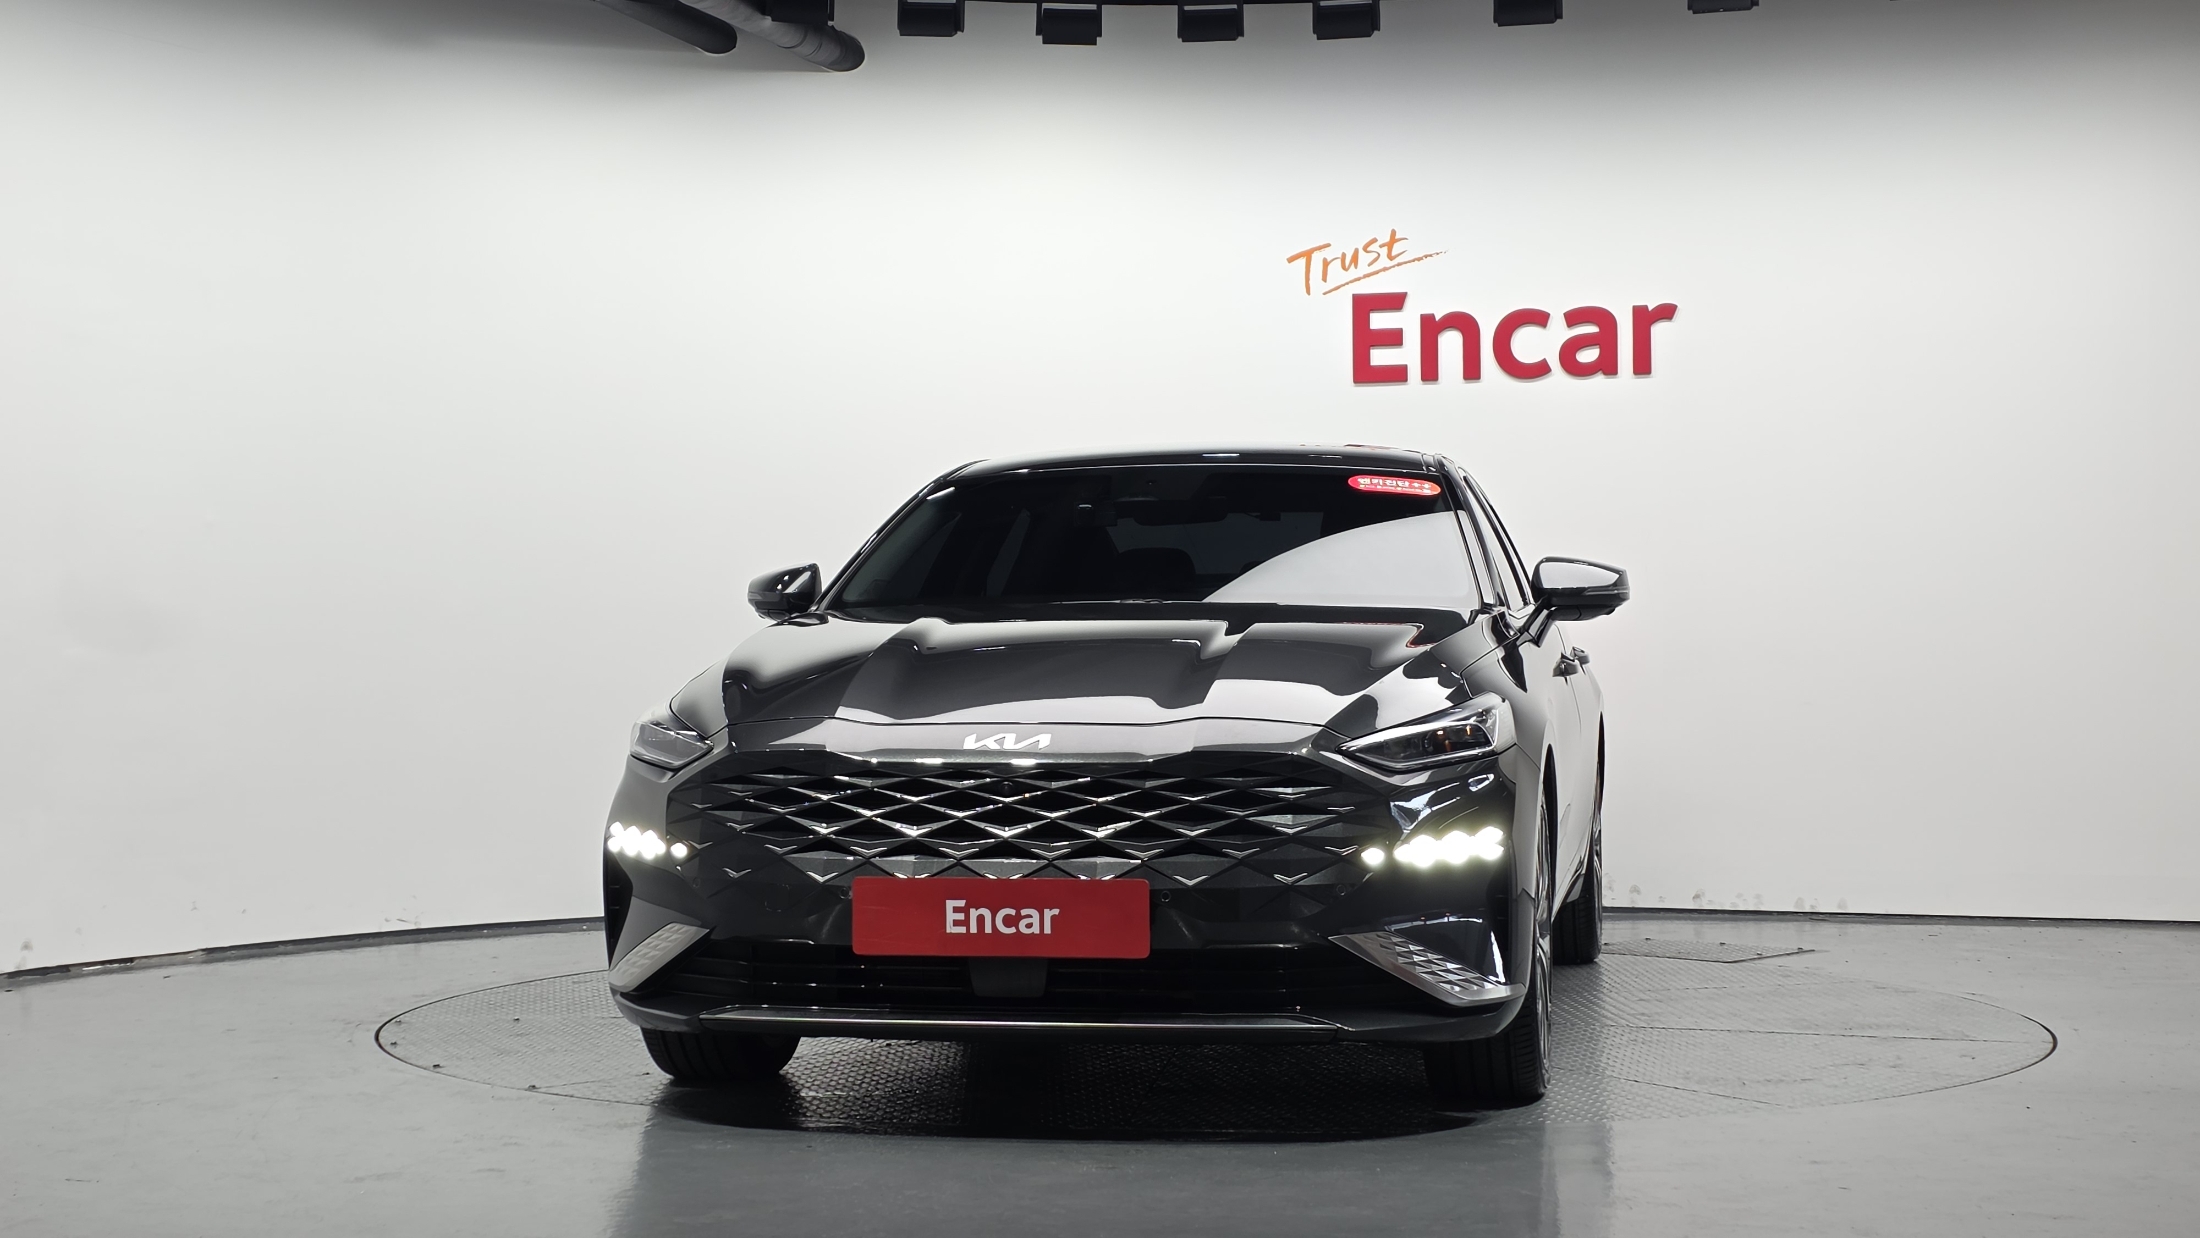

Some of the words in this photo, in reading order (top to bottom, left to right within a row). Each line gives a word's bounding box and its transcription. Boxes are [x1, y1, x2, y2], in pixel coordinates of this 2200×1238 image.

[1287, 228, 1409, 296] Trust
[1352, 292, 1678, 385] Encar
[963, 732, 1052, 750] KIA
[945, 899, 1060, 934] Encar
